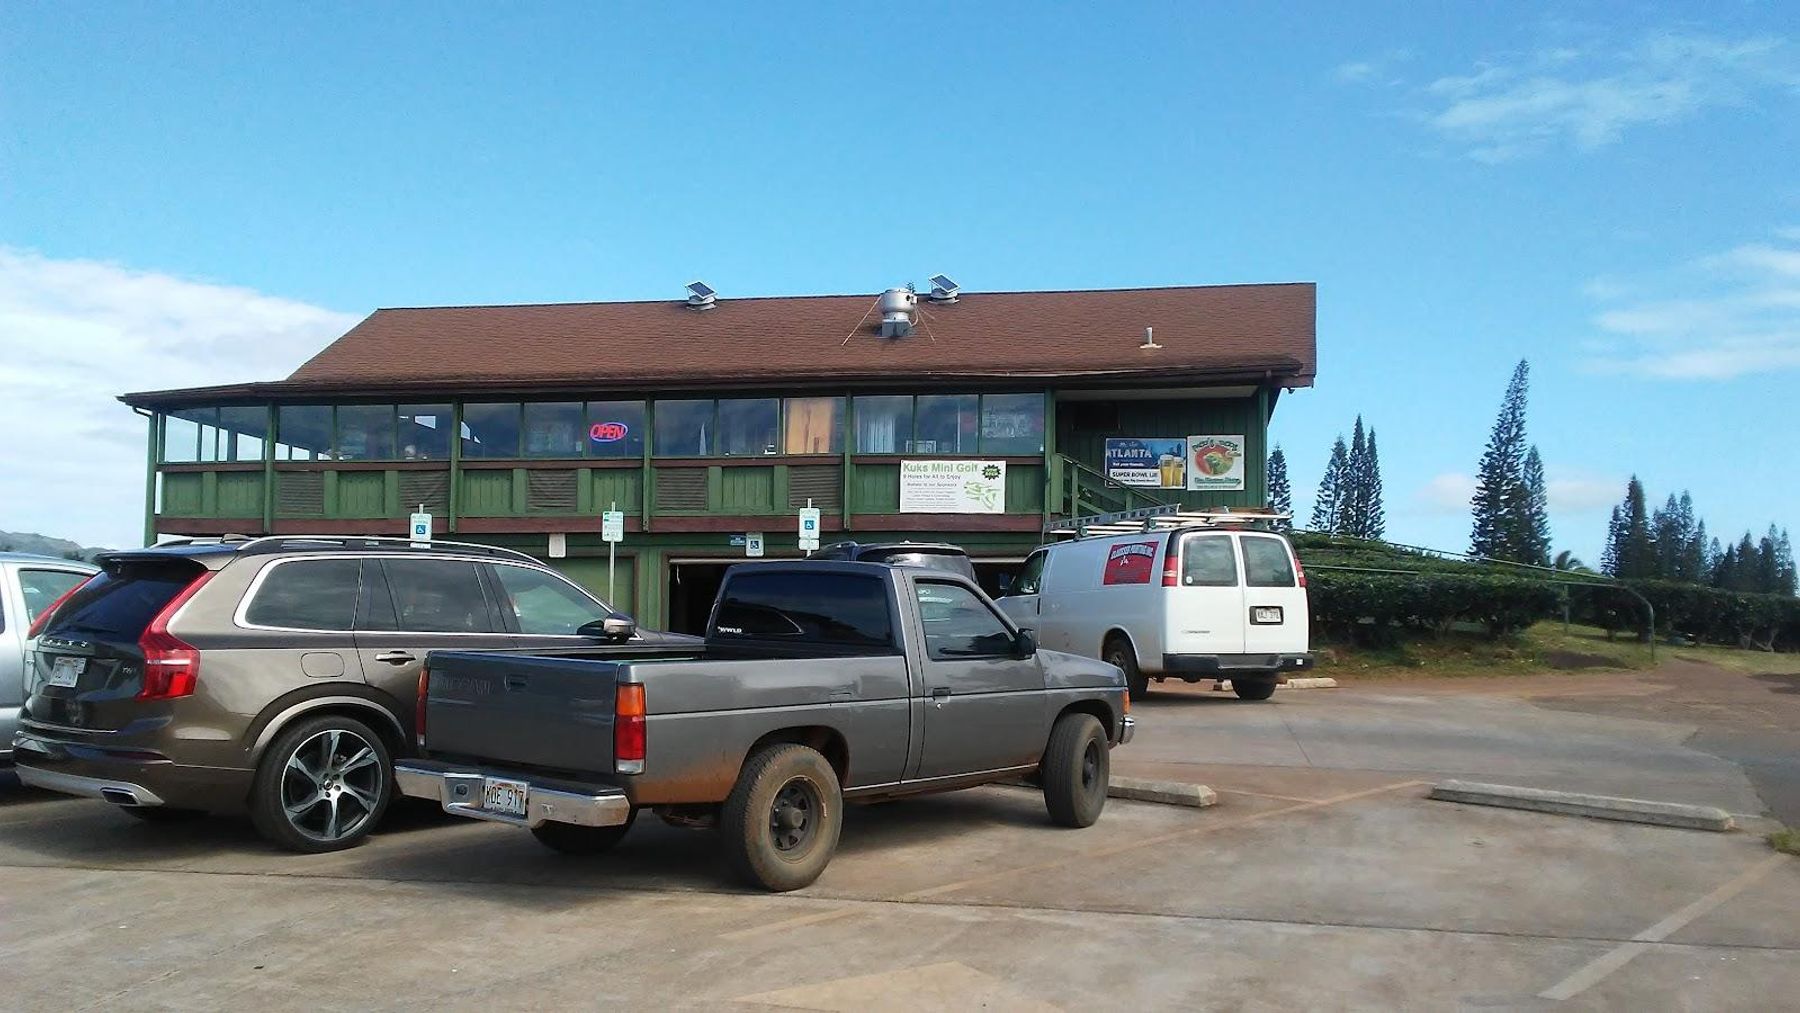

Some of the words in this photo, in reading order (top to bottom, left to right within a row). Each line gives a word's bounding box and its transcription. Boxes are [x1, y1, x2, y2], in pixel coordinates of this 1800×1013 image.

[591, 424, 625, 438] OPEN
[1106, 448, 1152, 458] ATLANTA
[903, 463, 929, 473] Kuks
[931, 463, 953, 473] Mini
[956, 463, 979, 473] Golf
[507, 789, 524, 808] 917
